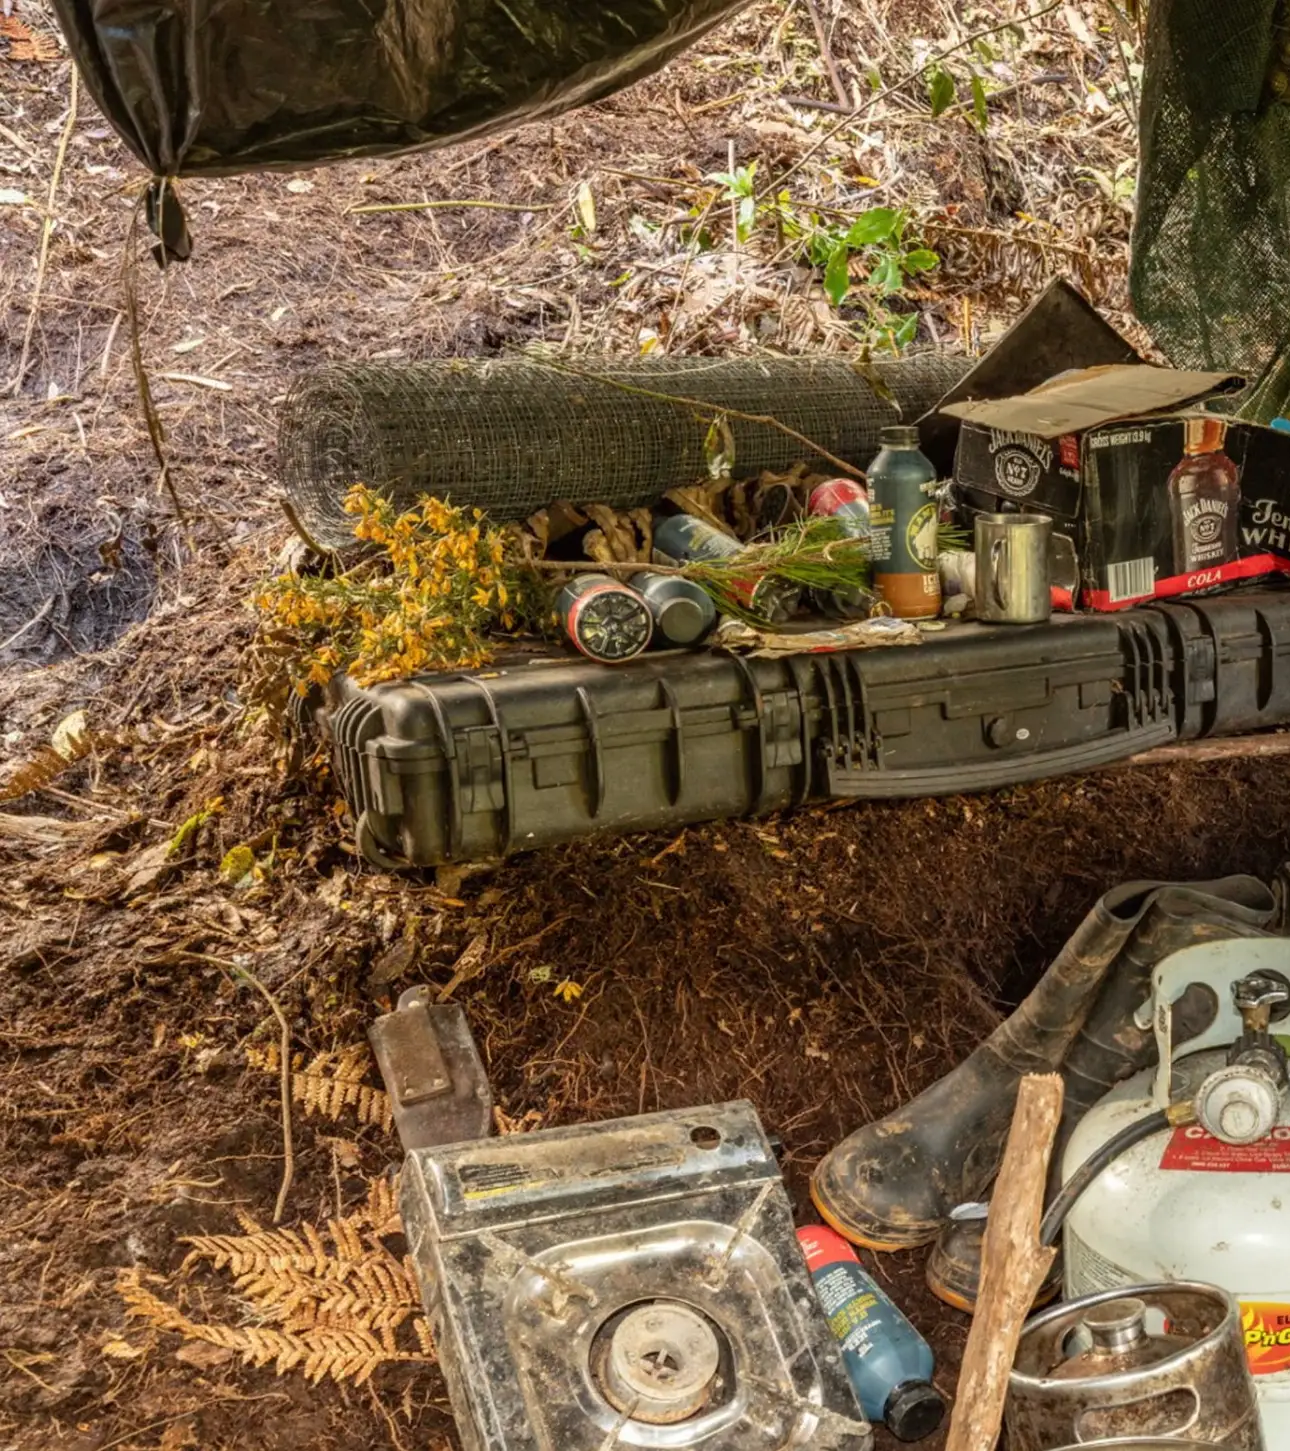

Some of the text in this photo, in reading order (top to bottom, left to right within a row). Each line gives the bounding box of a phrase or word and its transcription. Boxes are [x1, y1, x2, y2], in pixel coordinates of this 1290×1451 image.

[1110, 431, 1131, 446] WEIGHT
[1183, 498, 1229, 528] JACK DANIEL'S
[1190, 547, 1224, 562] WHISKEY
[1187, 569, 1222, 588] COLA
